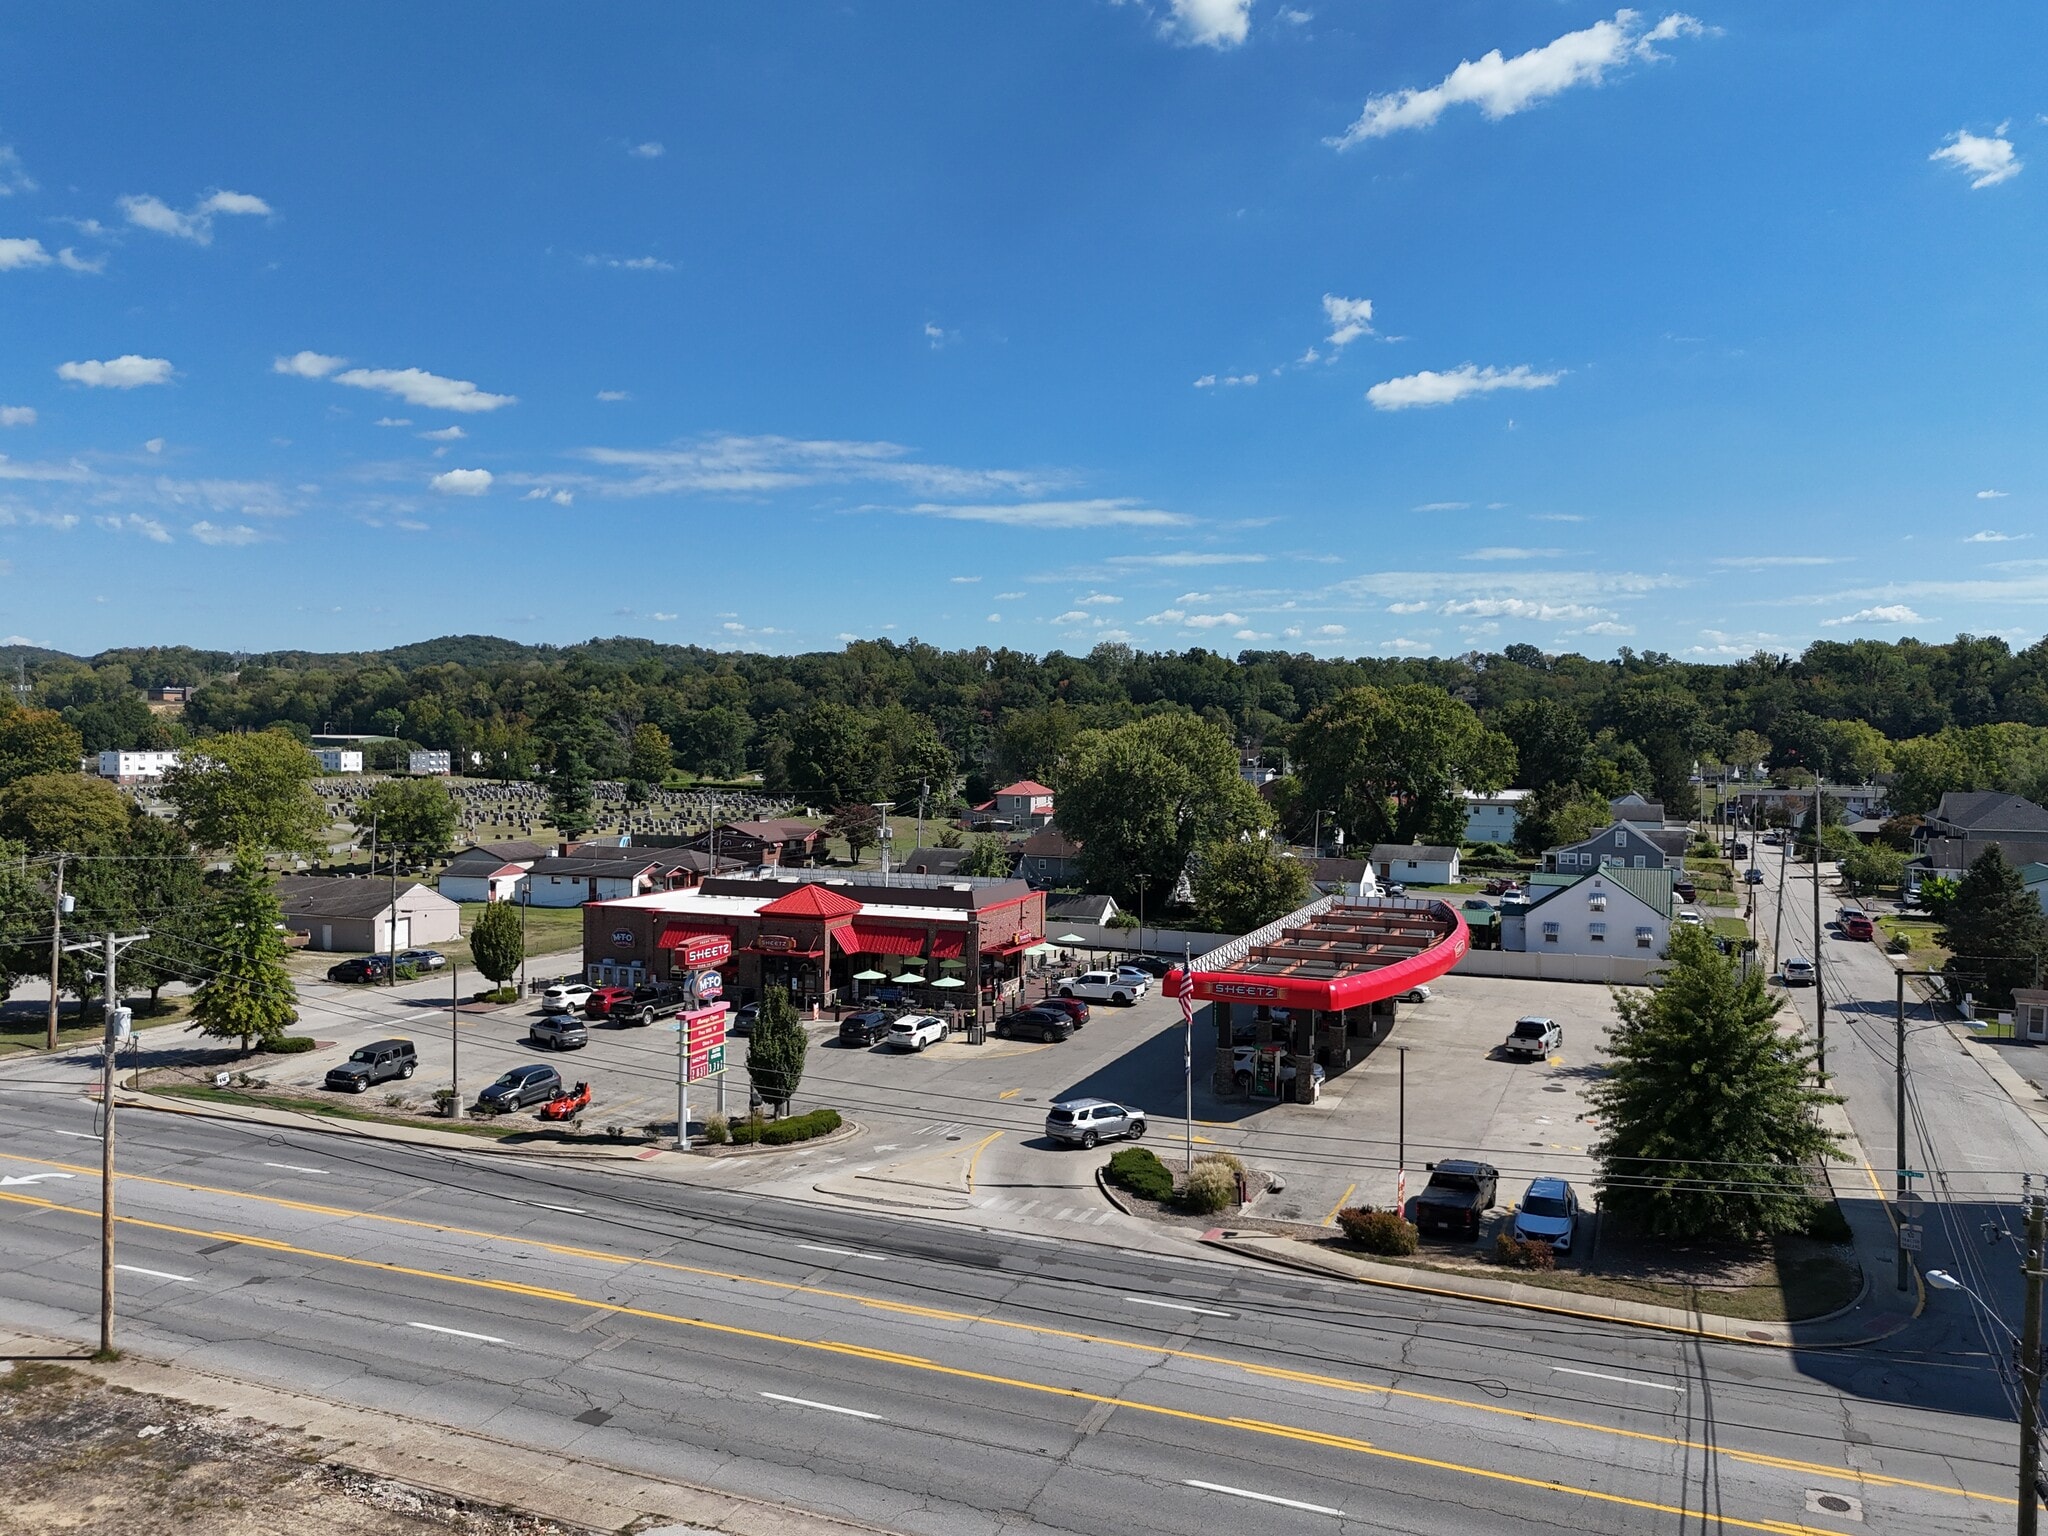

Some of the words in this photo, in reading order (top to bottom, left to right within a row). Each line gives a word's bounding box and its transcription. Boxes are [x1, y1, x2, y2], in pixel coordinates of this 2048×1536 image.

[761, 939, 787, 947] SHEETZ
[689, 944, 729, 961] SHEETZ
[1215, 984, 1274, 996] SHEETZ
